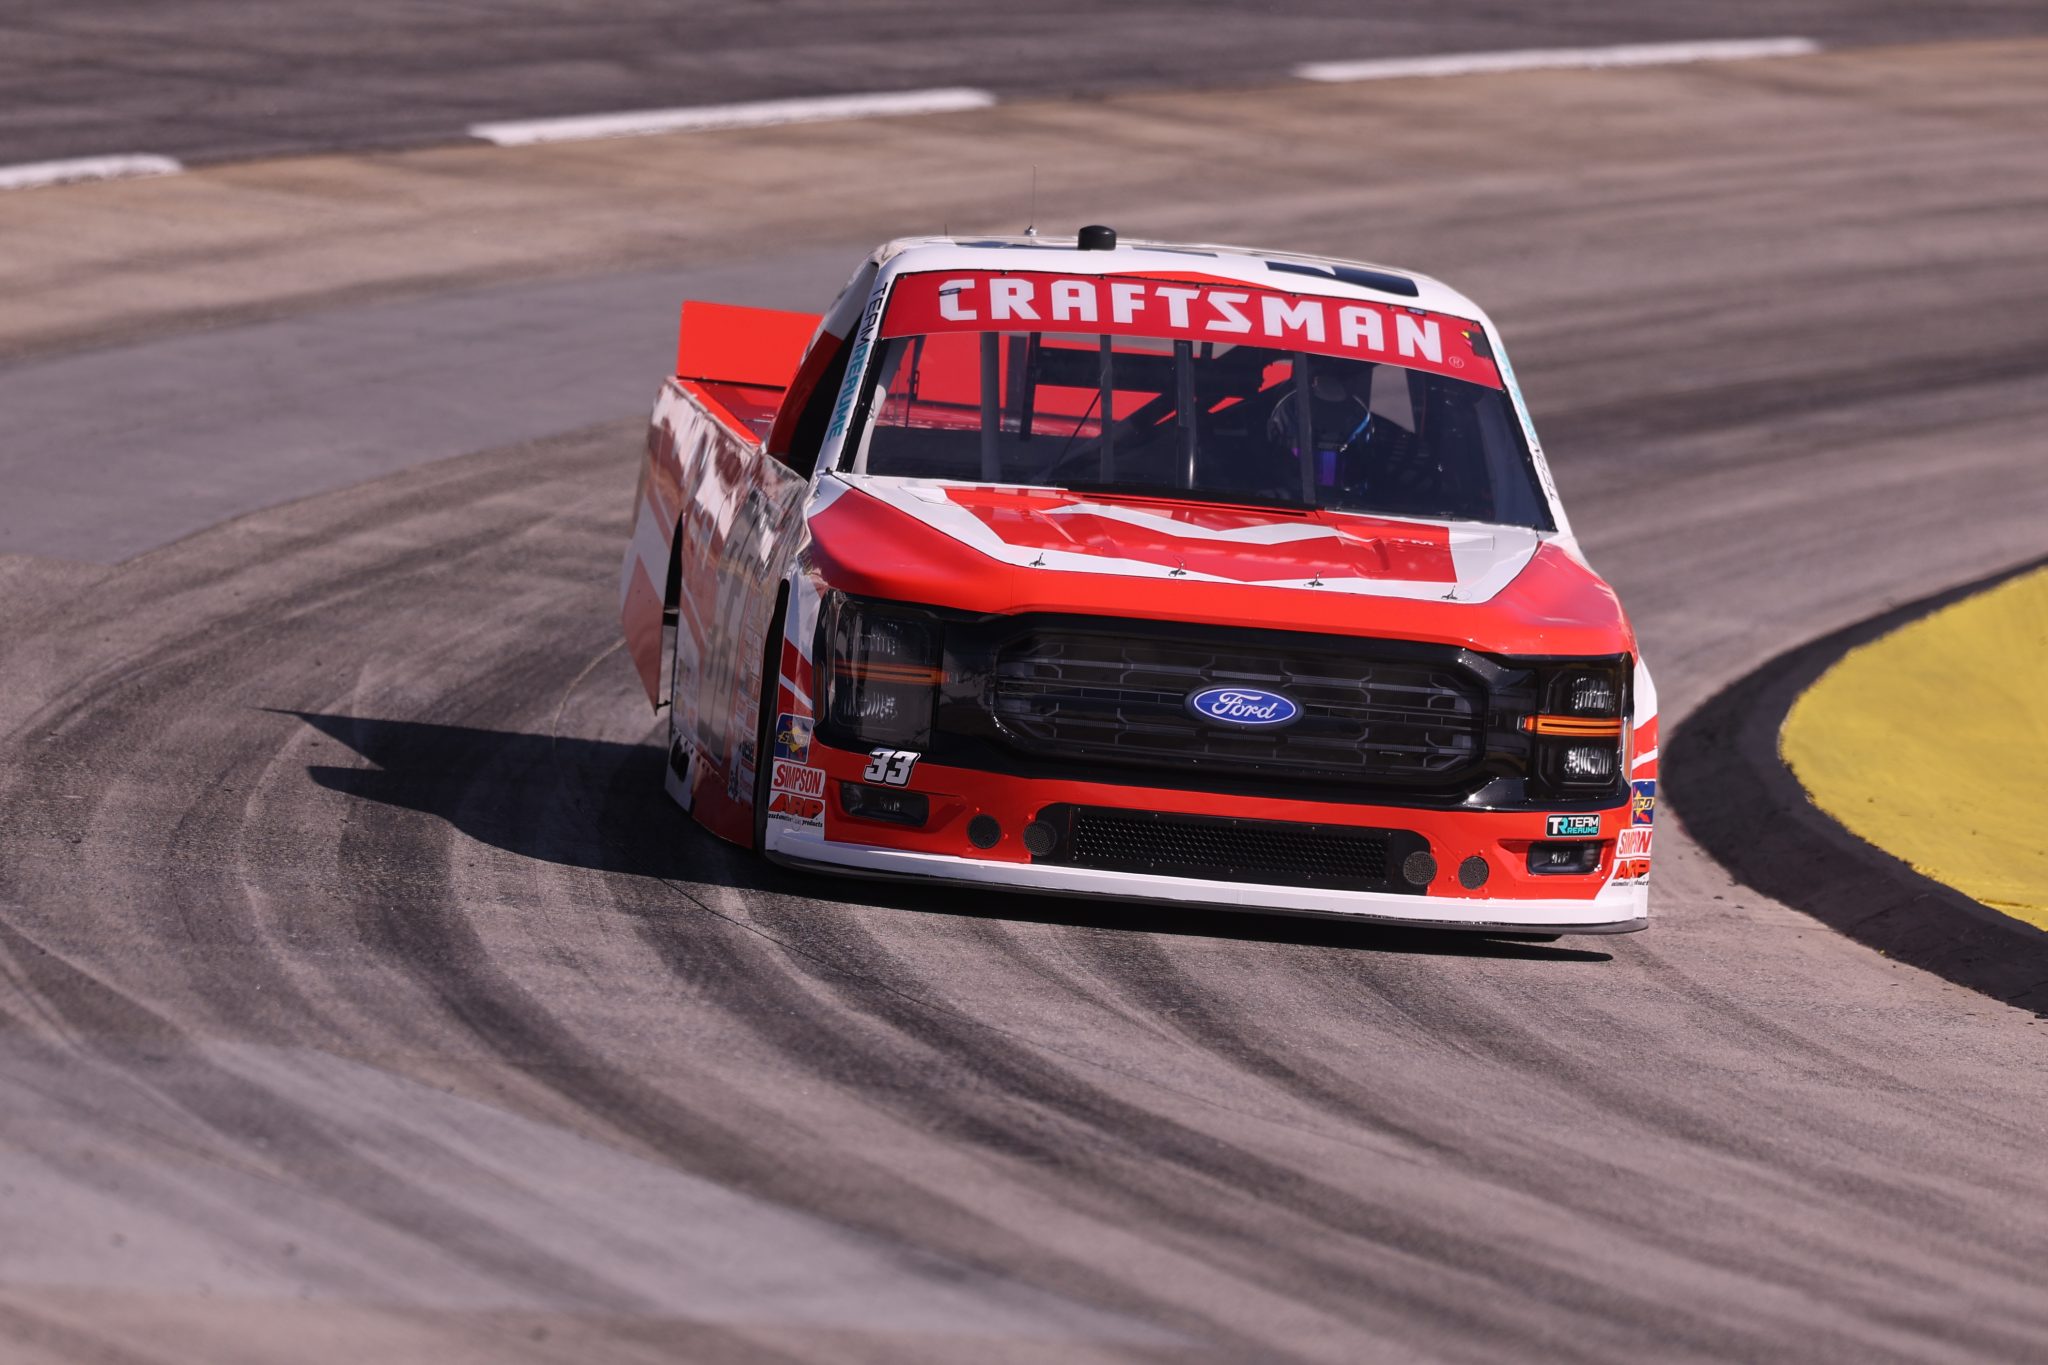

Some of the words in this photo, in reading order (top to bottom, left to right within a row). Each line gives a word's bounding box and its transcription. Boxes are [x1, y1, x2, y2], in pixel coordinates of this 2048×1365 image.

[938, 278, 1443, 364] CRAFTSMAN
[1212, 692, 1278, 719] Ford
[773, 763, 823, 796] SIMPSON
[863, 747, 920, 787] 33
[768, 792, 824, 819] ARP
[1568, 816, 1599, 827] TEAM
